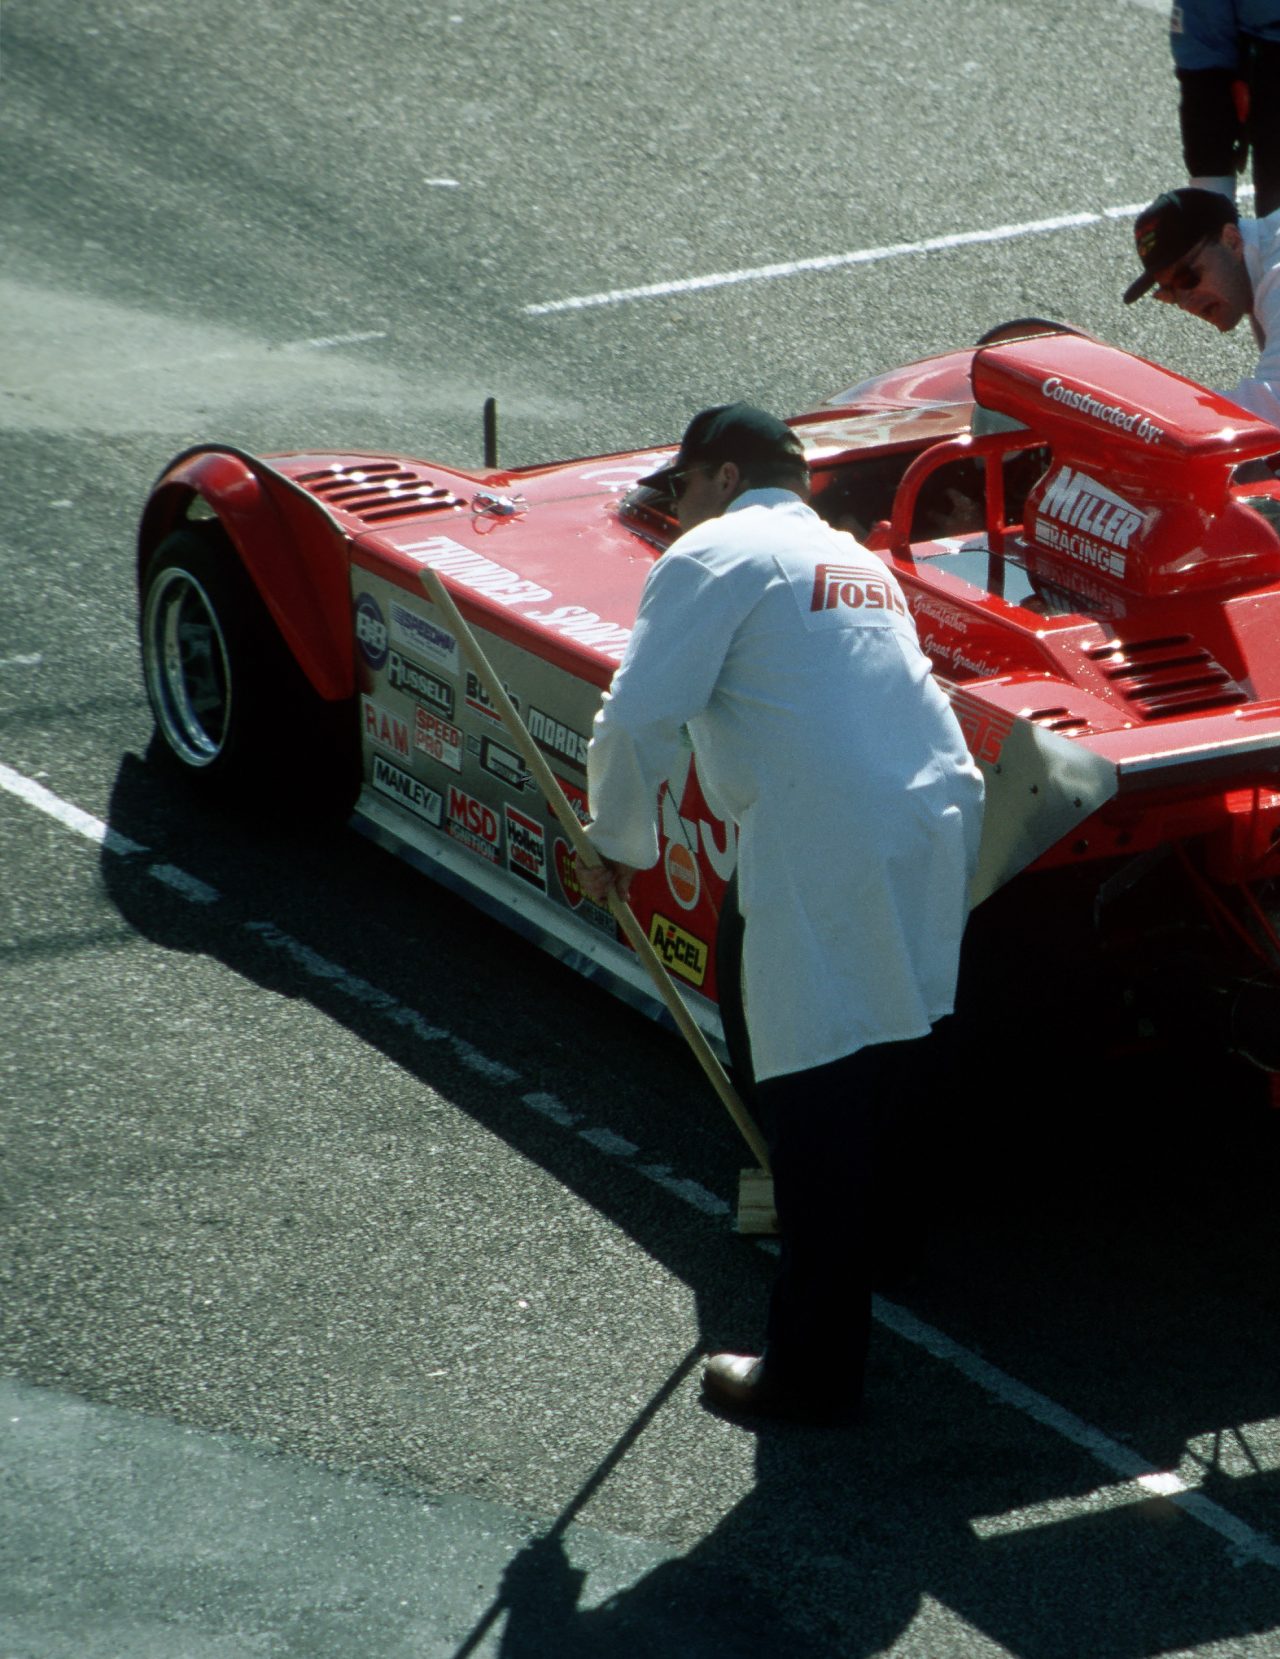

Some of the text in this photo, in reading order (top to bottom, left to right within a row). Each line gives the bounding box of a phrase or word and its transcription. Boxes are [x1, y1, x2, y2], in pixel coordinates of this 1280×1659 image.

[1041, 377, 1164, 444] Constructed by:
[1038, 466, 1147, 550] MILLER
[393, 536, 553, 605] THUNDER
[1049, 526, 1114, 572] RACING
[389, 653, 450, 706] RUSSELL
[365, 702, 409, 756] RAM
[415, 707, 459, 747] SPEED
[376, 761, 431, 813] MANLEY
[450, 787, 498, 842] MSD
[653, 924, 702, 973] ACCEL
